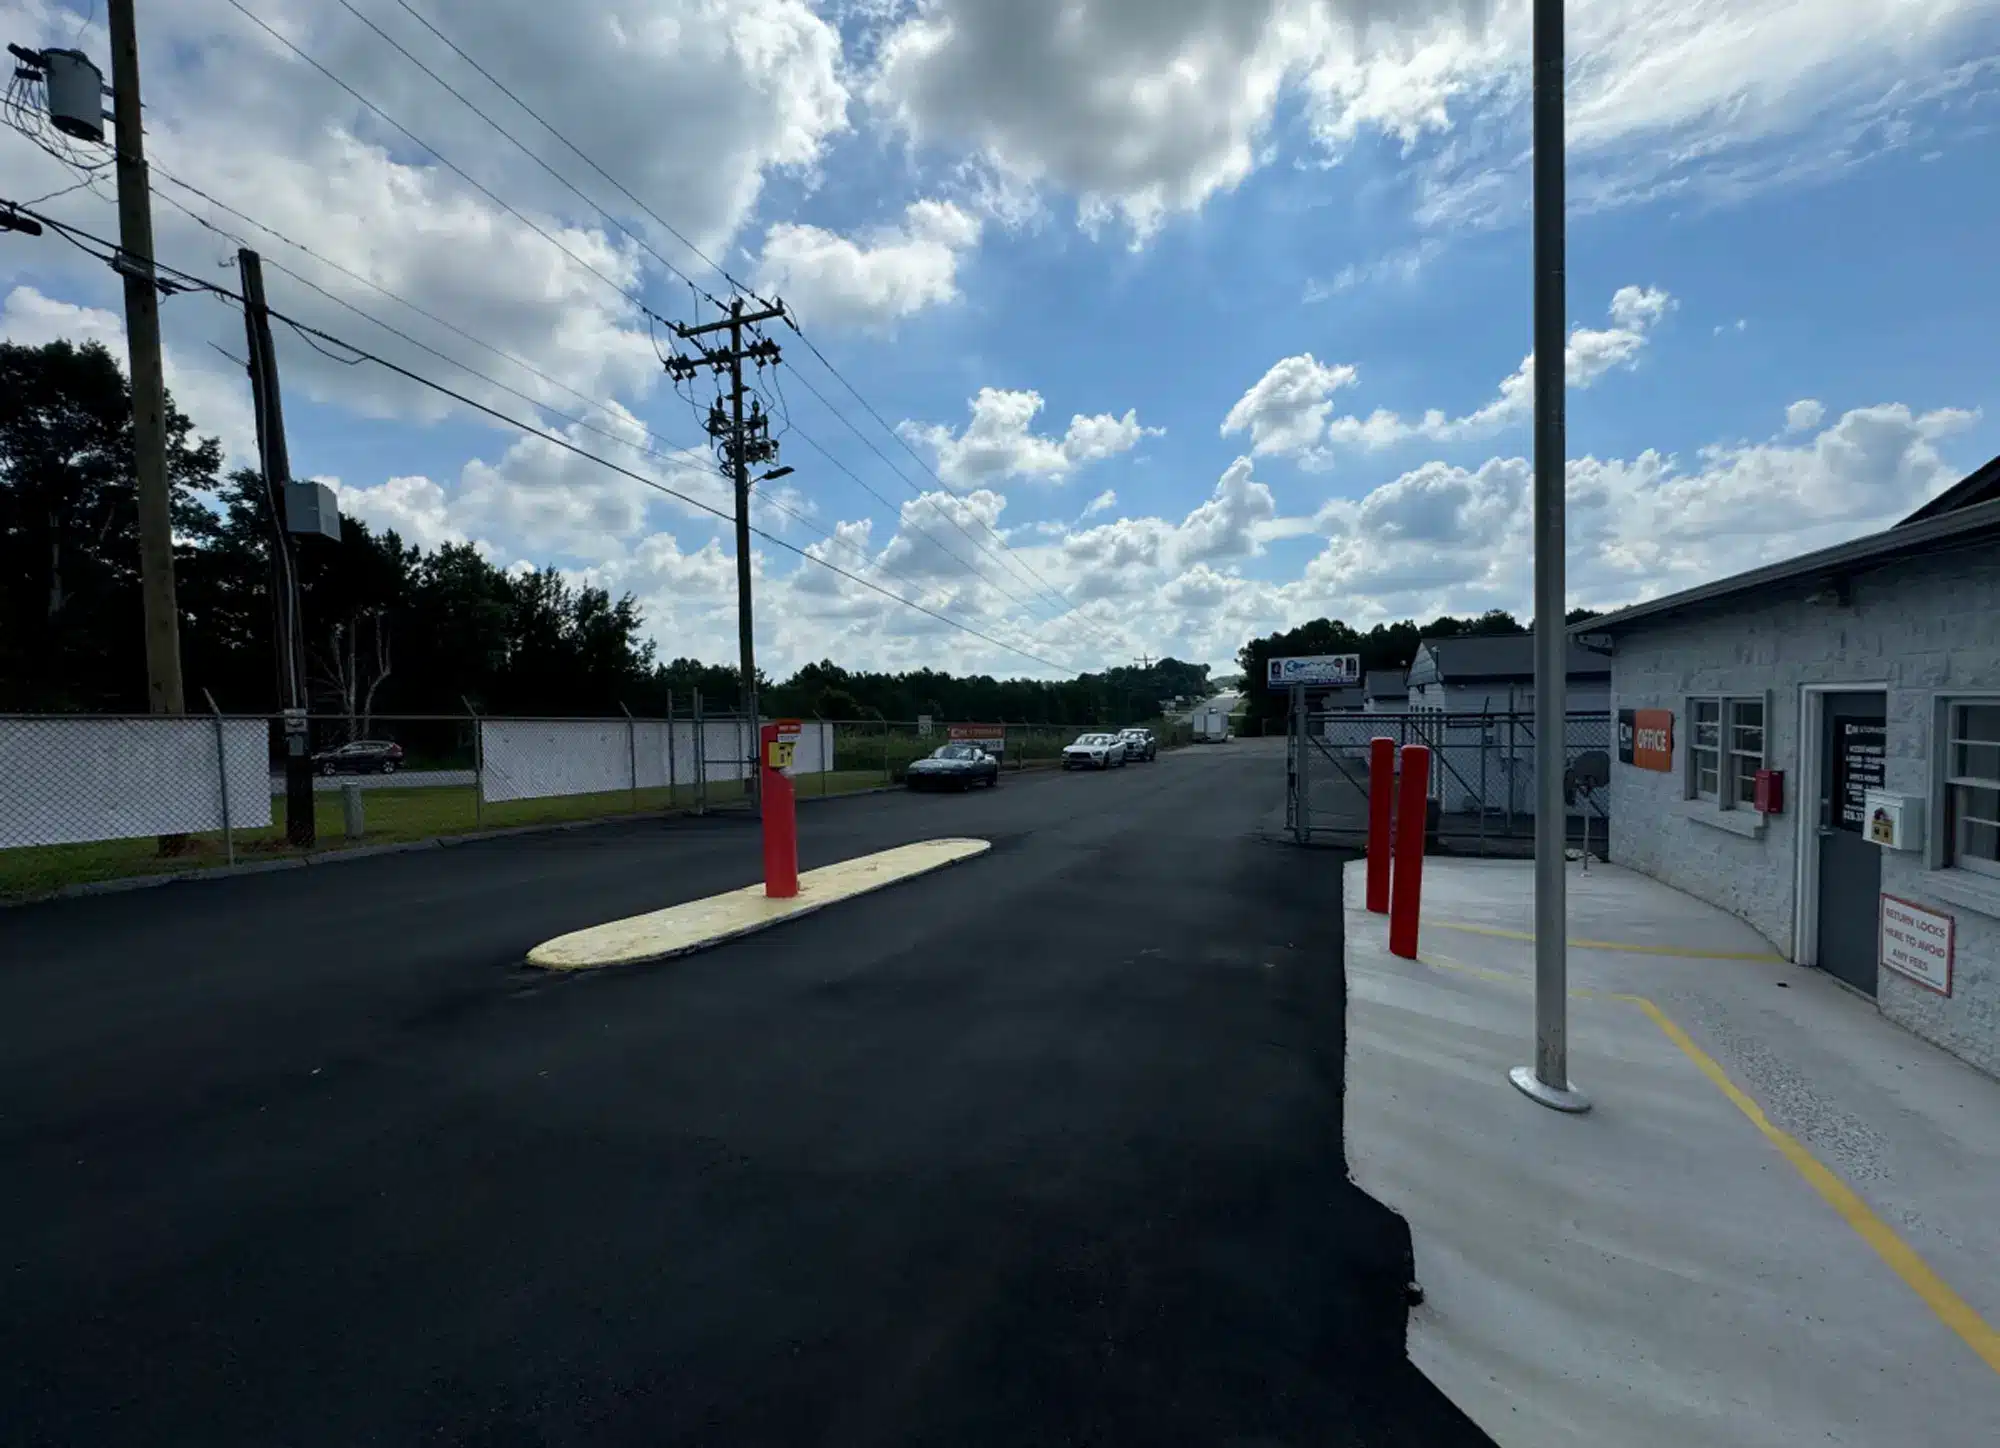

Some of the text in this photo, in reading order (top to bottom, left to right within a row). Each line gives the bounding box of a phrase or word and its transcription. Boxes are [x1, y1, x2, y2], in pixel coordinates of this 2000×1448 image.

[1637, 728, 1666, 752] OFFICE
[1886, 908, 1945, 939] RETURN LOCKS
[1885, 926, 1945, 958] HERE TO AVOID
[1893, 948, 1928, 971] ANY FEES
